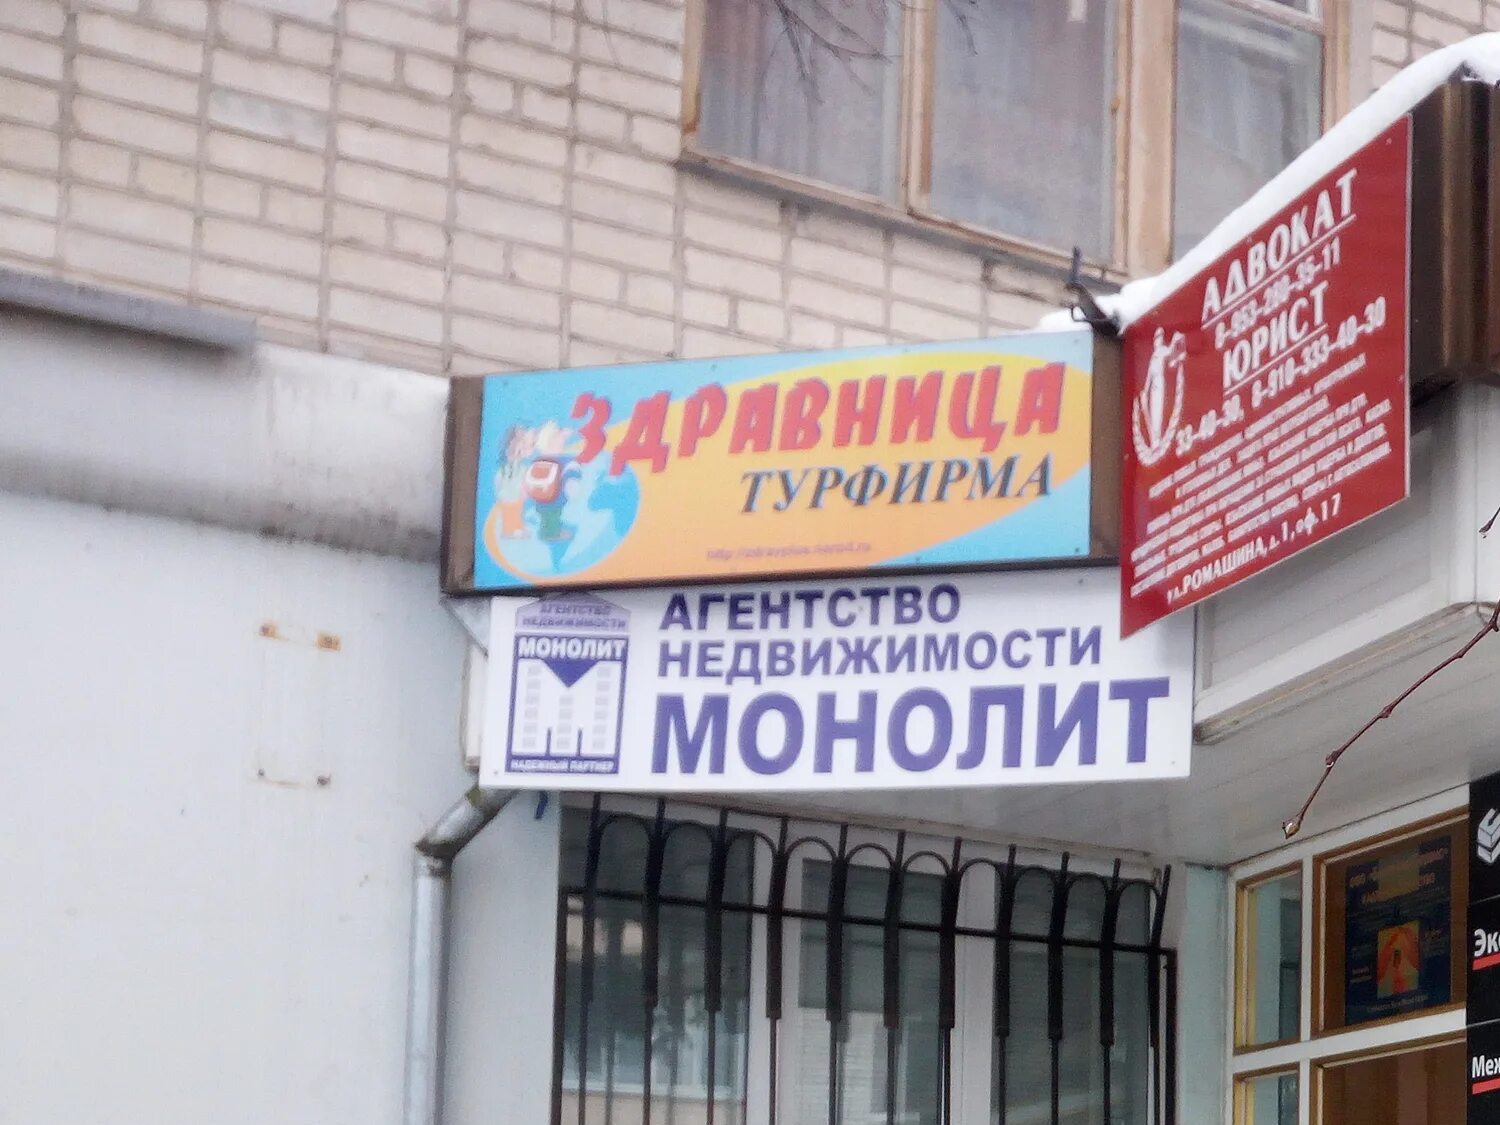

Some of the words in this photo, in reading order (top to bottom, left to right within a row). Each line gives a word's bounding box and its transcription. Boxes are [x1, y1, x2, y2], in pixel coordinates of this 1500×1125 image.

[1202, 168, 1357, 322] АДВОКАТ
[1223, 280, 1328, 389] ЮРИСТ
[568, 361, 1067, 476] ЗДРАВНИЦА
[741, 454, 1054, 515] ТУРФИРМА
[660, 582, 960, 631] АГЕНТСТВО
[518, 636, 626, 660] МОНОЛИТ
[657, 625, 1102, 686] НЕДВИЖИМОСТИ
[651, 676, 1170, 776] МОНОЛИТ
